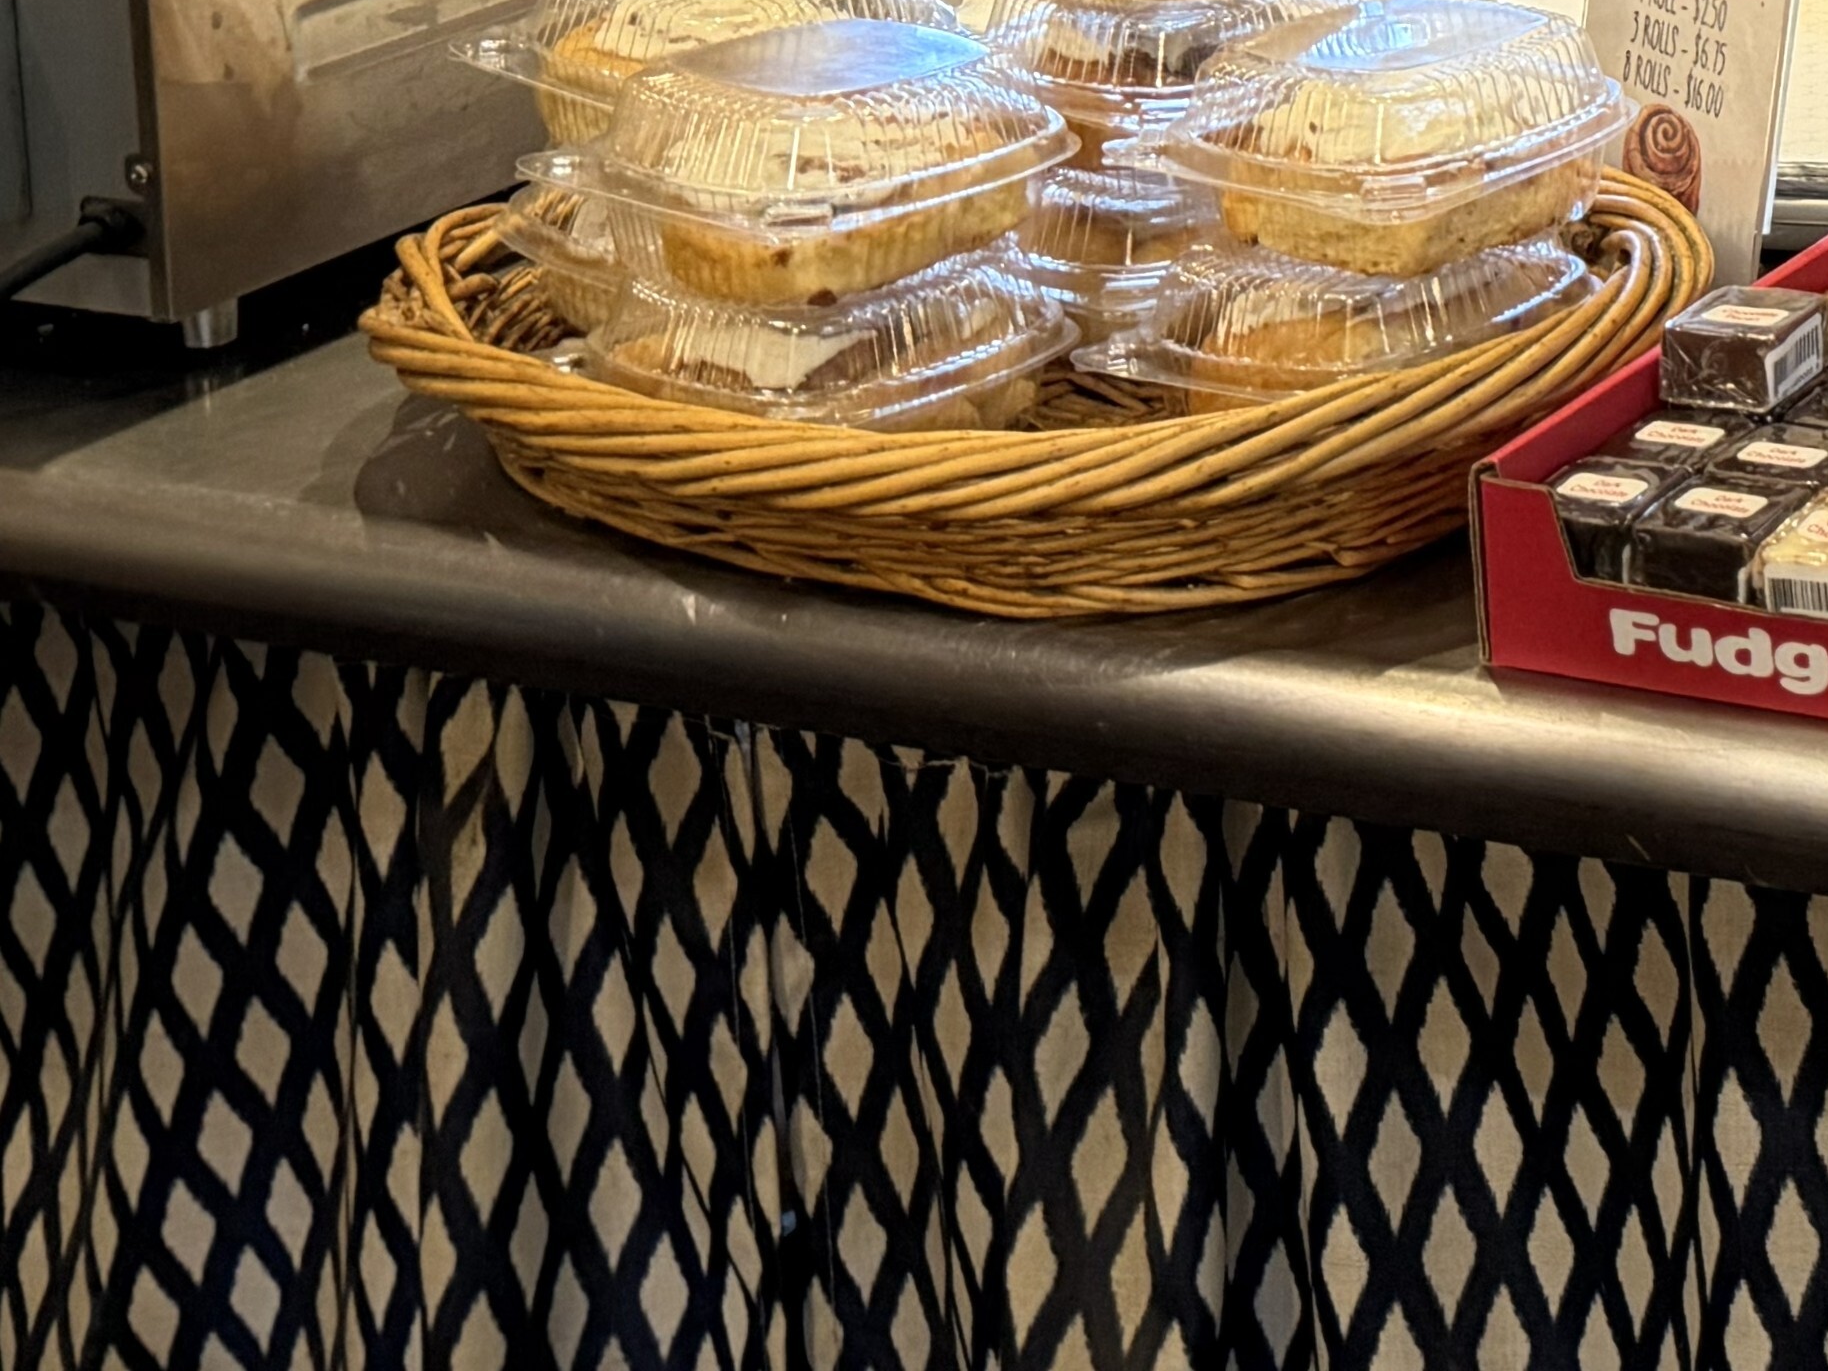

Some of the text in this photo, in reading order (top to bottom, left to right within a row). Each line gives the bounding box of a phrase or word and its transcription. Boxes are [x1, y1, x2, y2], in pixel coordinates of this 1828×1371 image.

[1629, 9, 1728, 77] 3 ROLLS $6.75
[1622, 49, 1725, 119] 8 ROLLS $16.00
[1569, 484, 1629, 499] Chocolate
[1690, 499, 1751, 514] Chocolate
[1714, 494, 1743, 505] Dark
